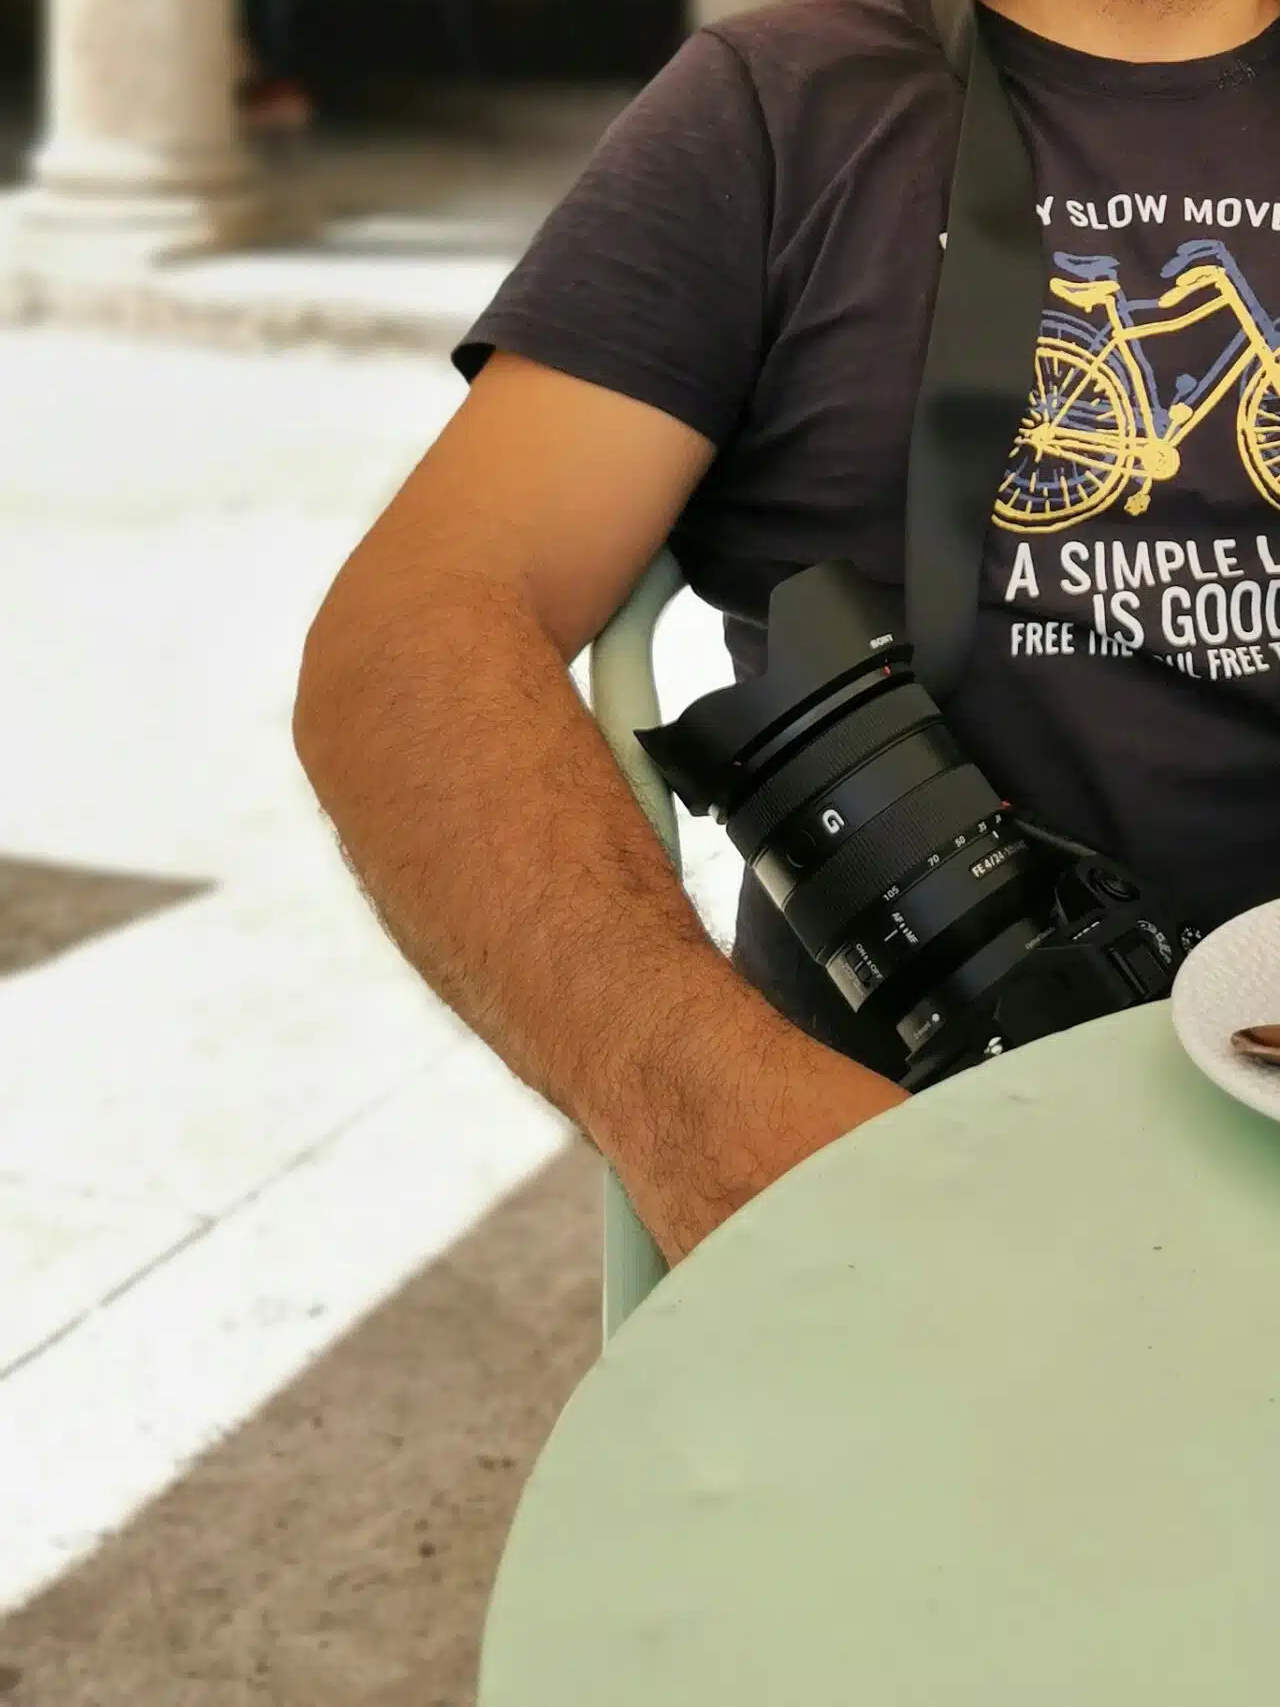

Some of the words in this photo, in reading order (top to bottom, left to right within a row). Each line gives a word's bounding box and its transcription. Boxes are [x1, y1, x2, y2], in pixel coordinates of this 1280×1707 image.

[1066, 194, 1168, 231] SLOW
[1004, 541, 1040, 602] A
[1060, 538, 1245, 595] SIMPLE
[1092, 590, 1145, 650] IS
[1010, 622, 1074, 657] FREE
[1207, 646, 1271, 682] FREE
[822, 808, 845, 835] G
[882, 885, 900, 901] 105
[927, 854, 940, 867] 70
